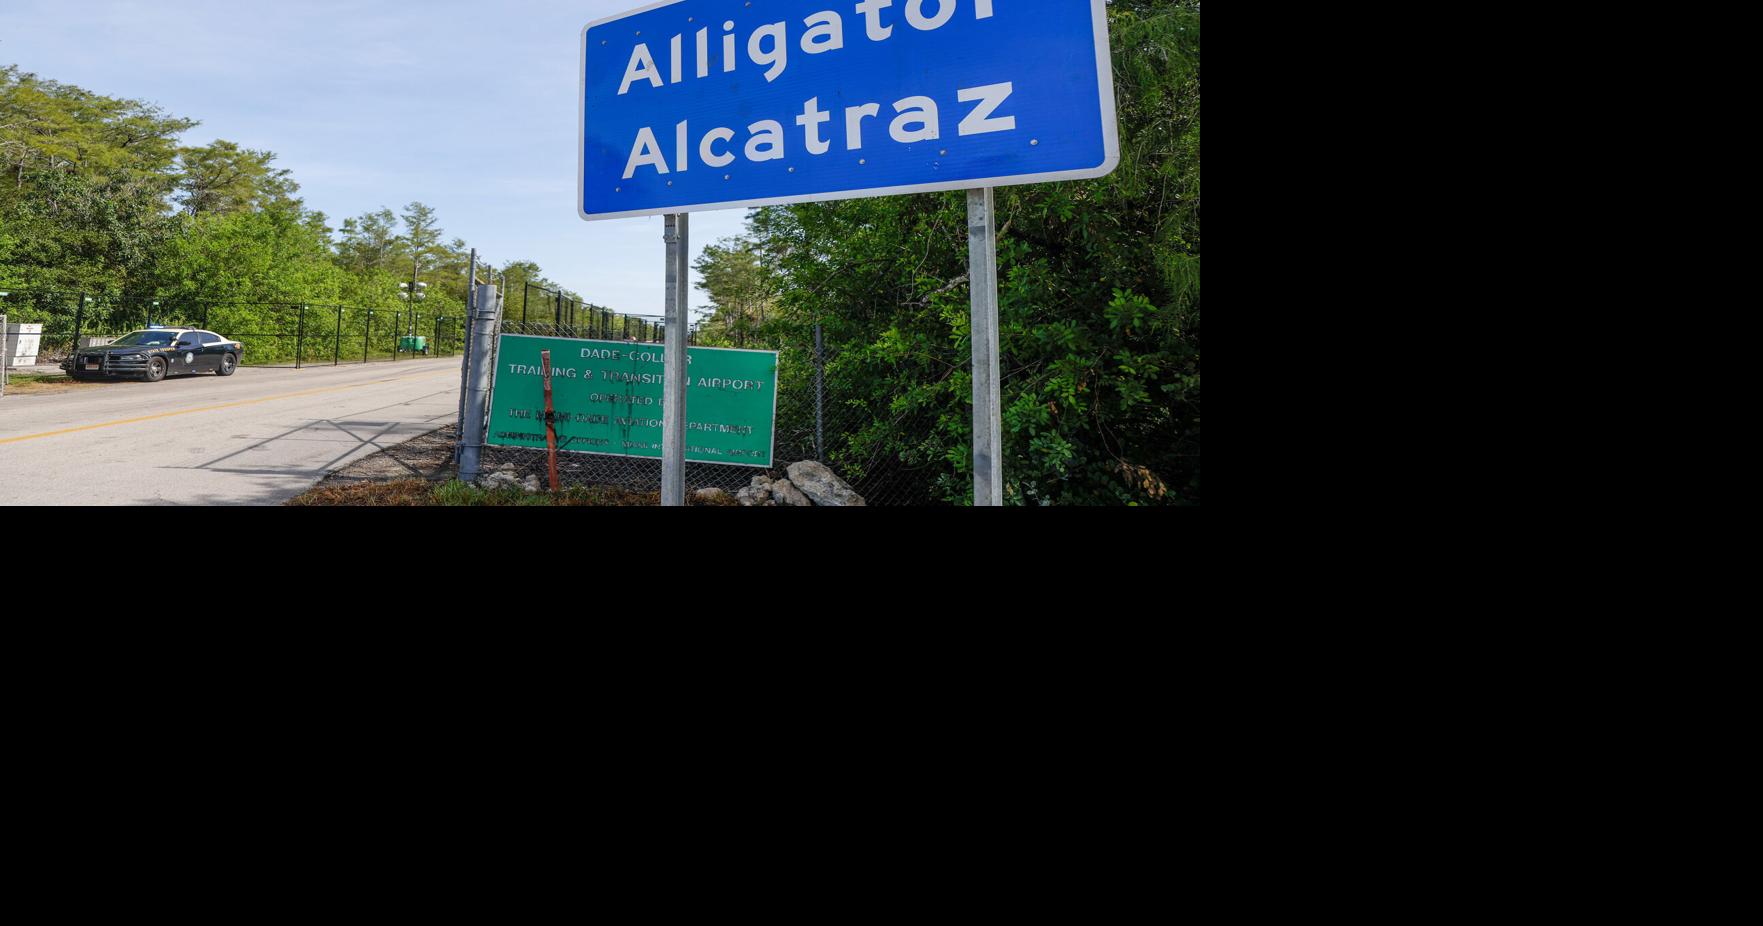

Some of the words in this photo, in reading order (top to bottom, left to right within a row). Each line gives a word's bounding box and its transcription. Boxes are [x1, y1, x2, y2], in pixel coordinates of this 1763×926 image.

[621, 81, 1016, 180] Alcatraz
[508, 363, 577, 379] TRAIING
[583, 368, 594, 380] &
[697, 376, 764, 391] AIRPORT
